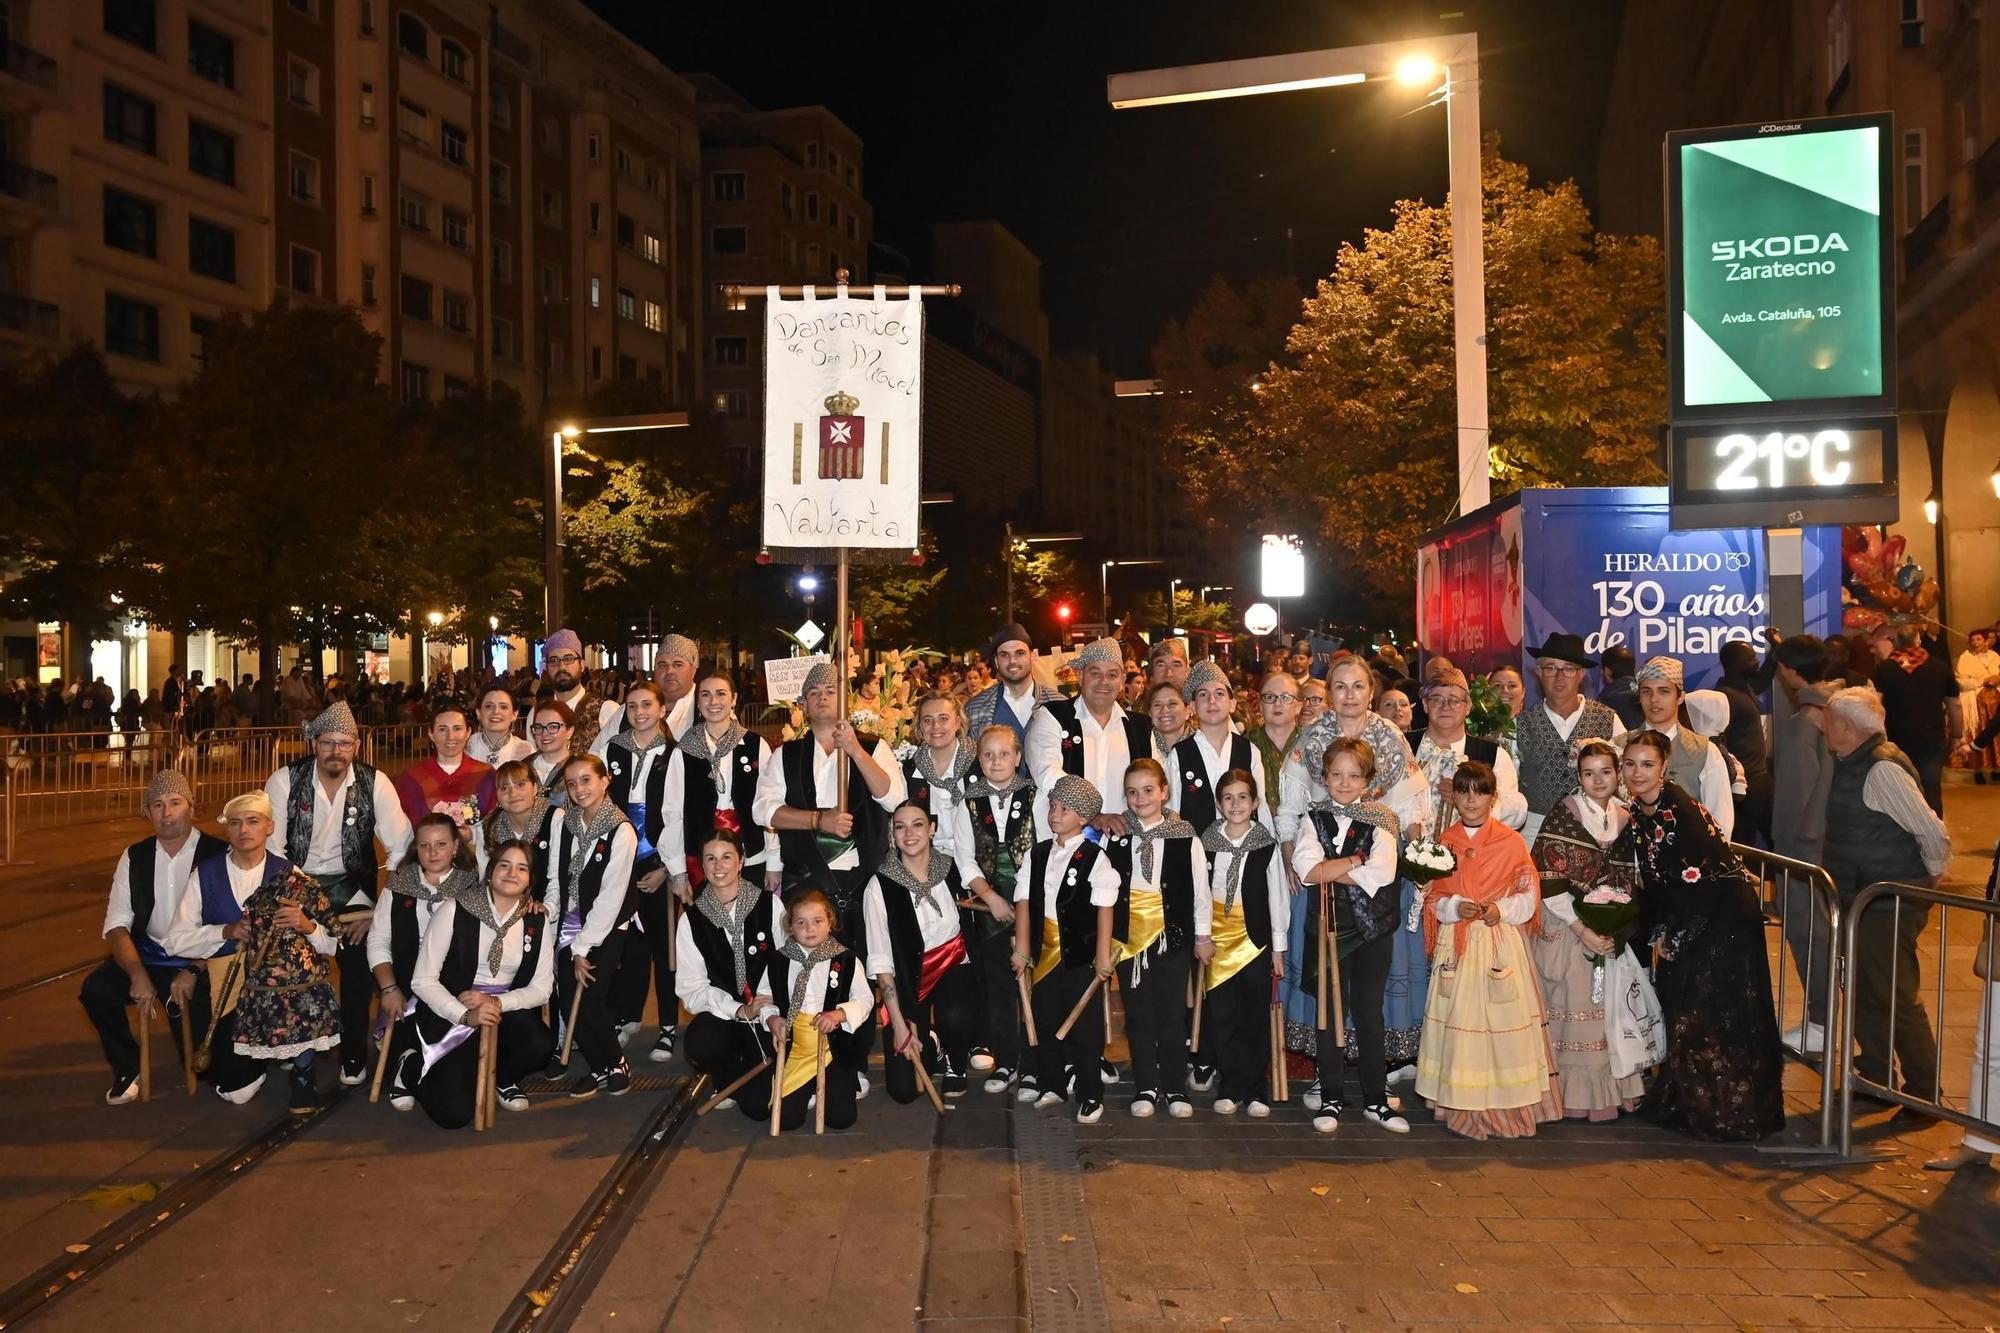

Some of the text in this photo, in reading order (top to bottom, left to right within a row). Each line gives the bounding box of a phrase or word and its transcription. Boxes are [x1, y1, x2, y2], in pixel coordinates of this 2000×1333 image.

[1758, 124, 1801, 133] JCDecaux
[1725, 260, 1836, 281] Zaratecno
[1721, 305, 1841, 324] Avda. Cataluña, 105
[788, 342, 803, 357] de
[811, 339, 841, 367] San
[1716, 429, 1850, 490] 21°C
[1604, 552, 1722, 572] HERALDO
[1592, 580, 1765, 617] 130 años
[1583, 617, 1766, 655] de Pilares
